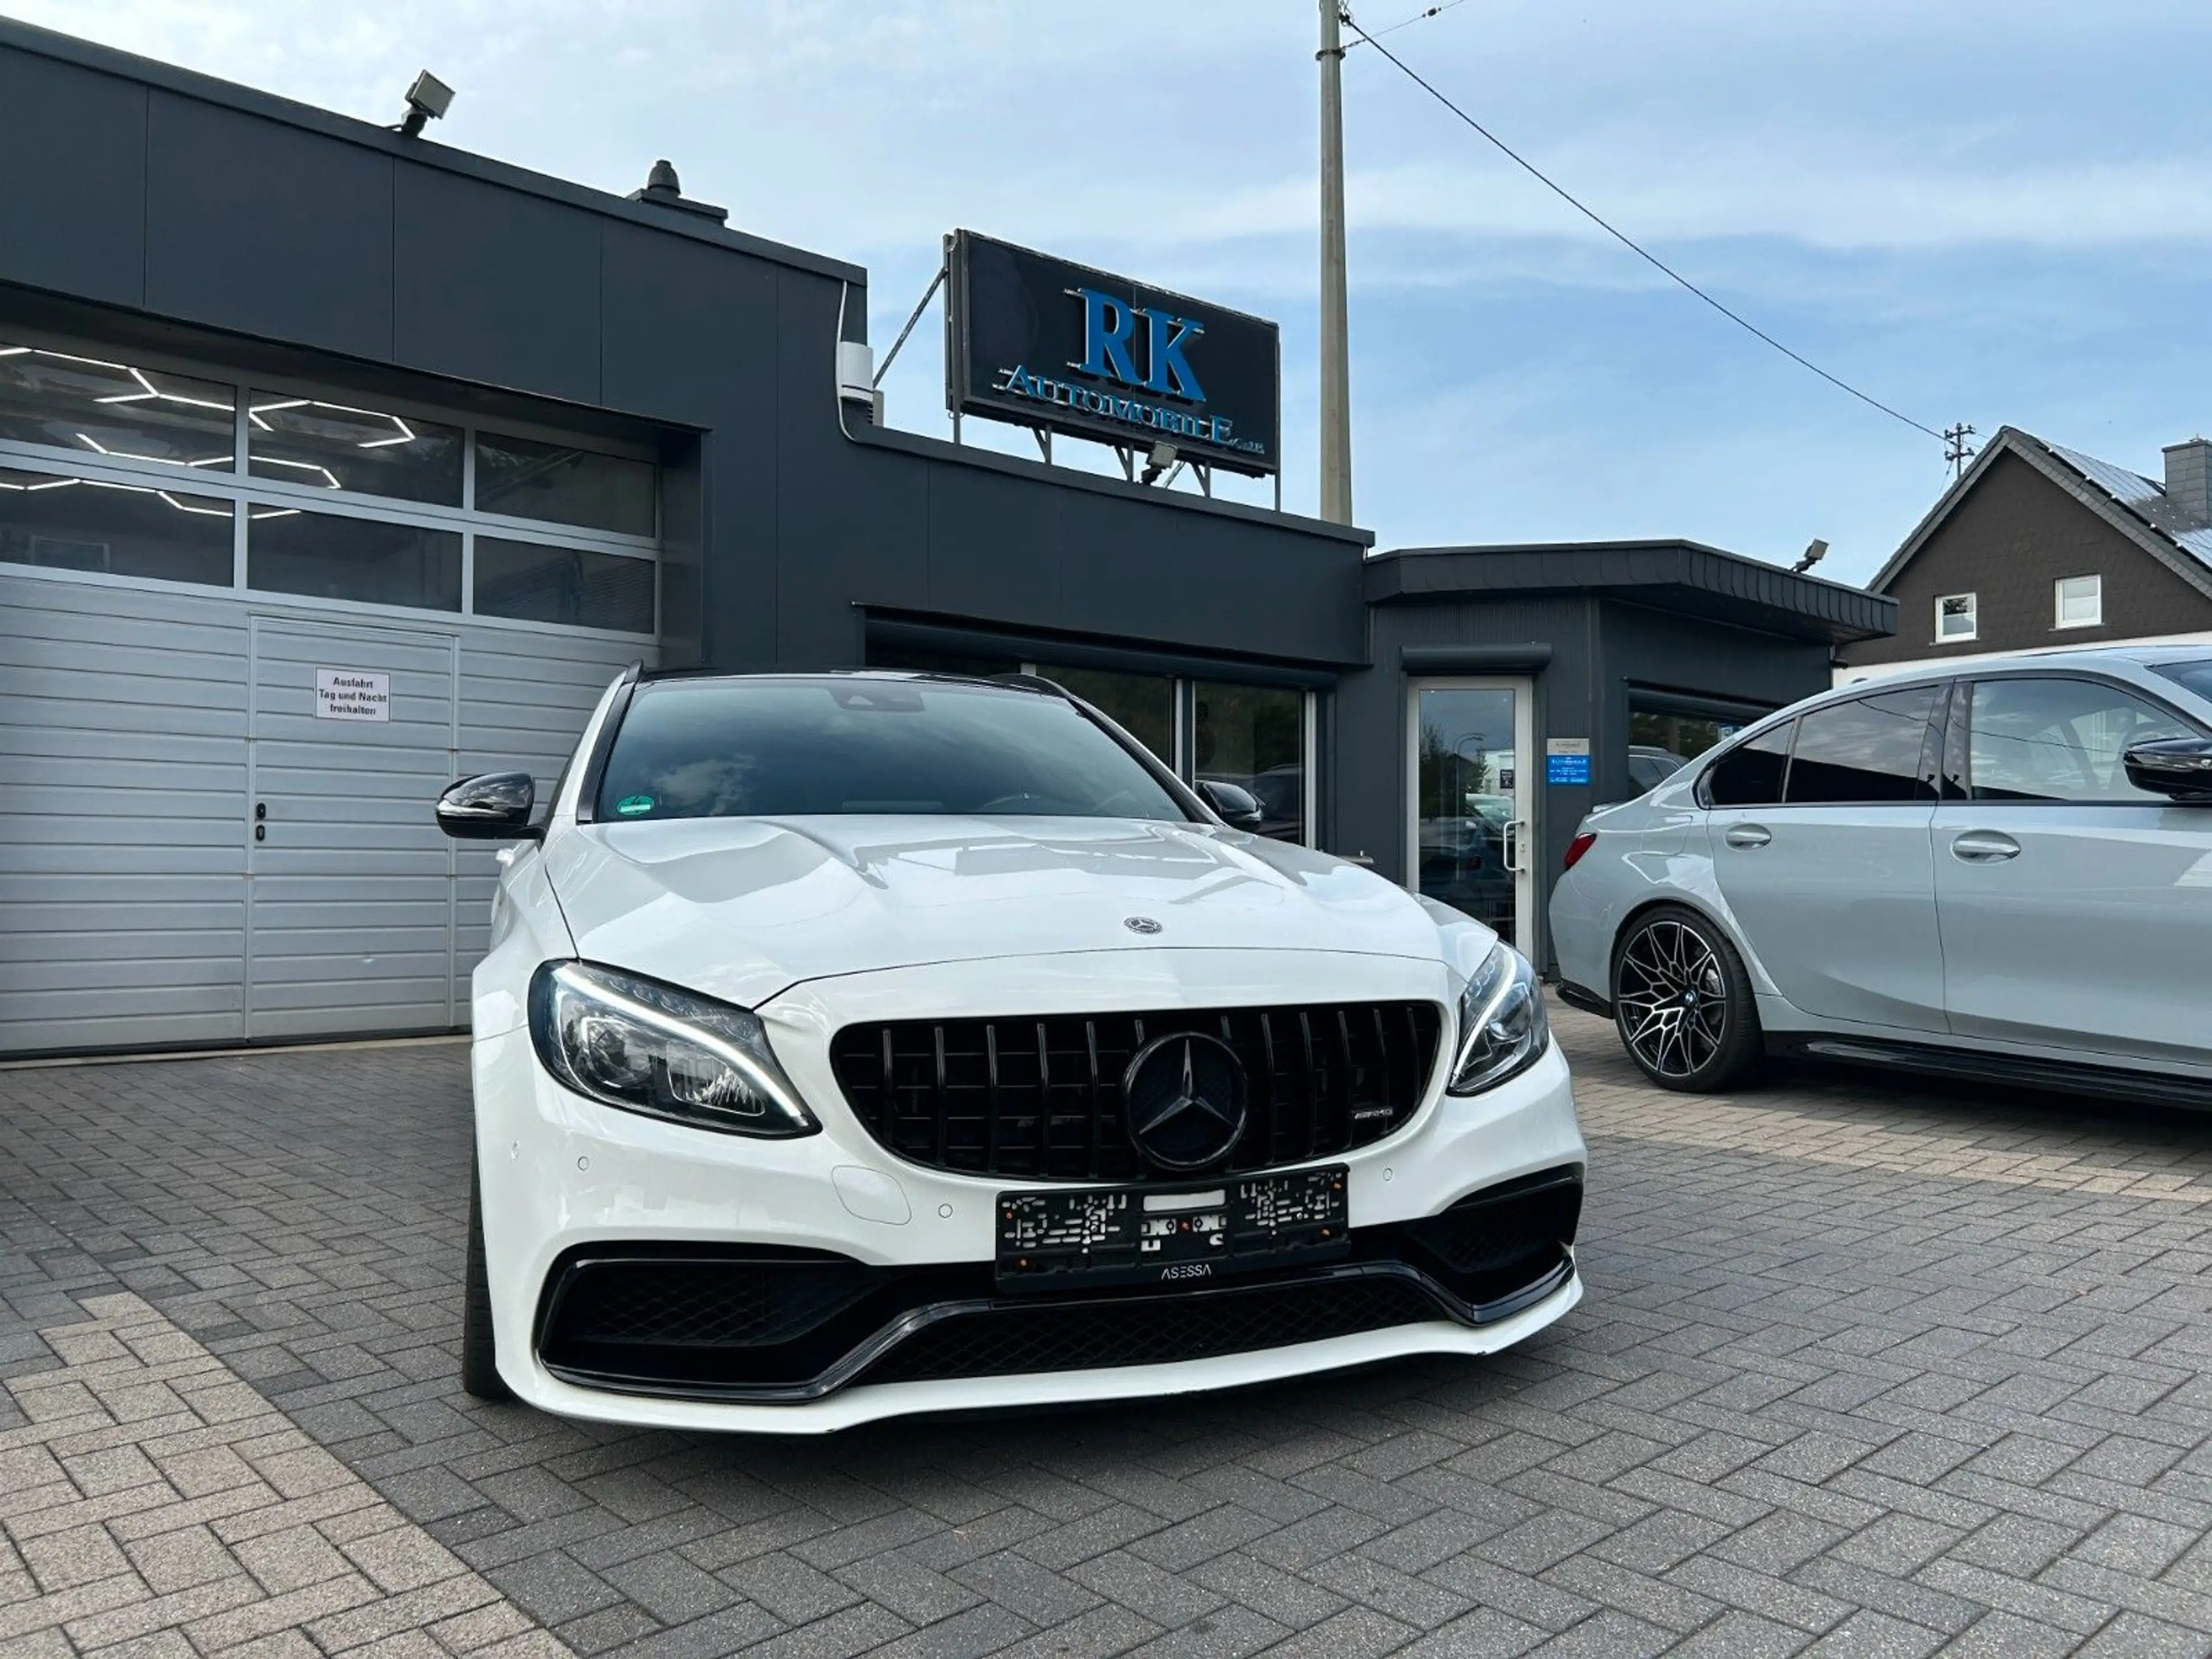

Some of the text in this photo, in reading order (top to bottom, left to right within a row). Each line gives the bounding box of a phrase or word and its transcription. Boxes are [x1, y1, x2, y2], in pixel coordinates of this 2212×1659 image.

[1063, 287, 1206, 402] RK
[992, 365, 1233, 445] AUTOMOBILE
[333, 677, 373, 688] Ausfahrt
[319, 688, 387, 702] Tag und Nacht
[330, 704, 376, 715] freihalten
[1161, 1263, 1212, 1279] ASESSA
